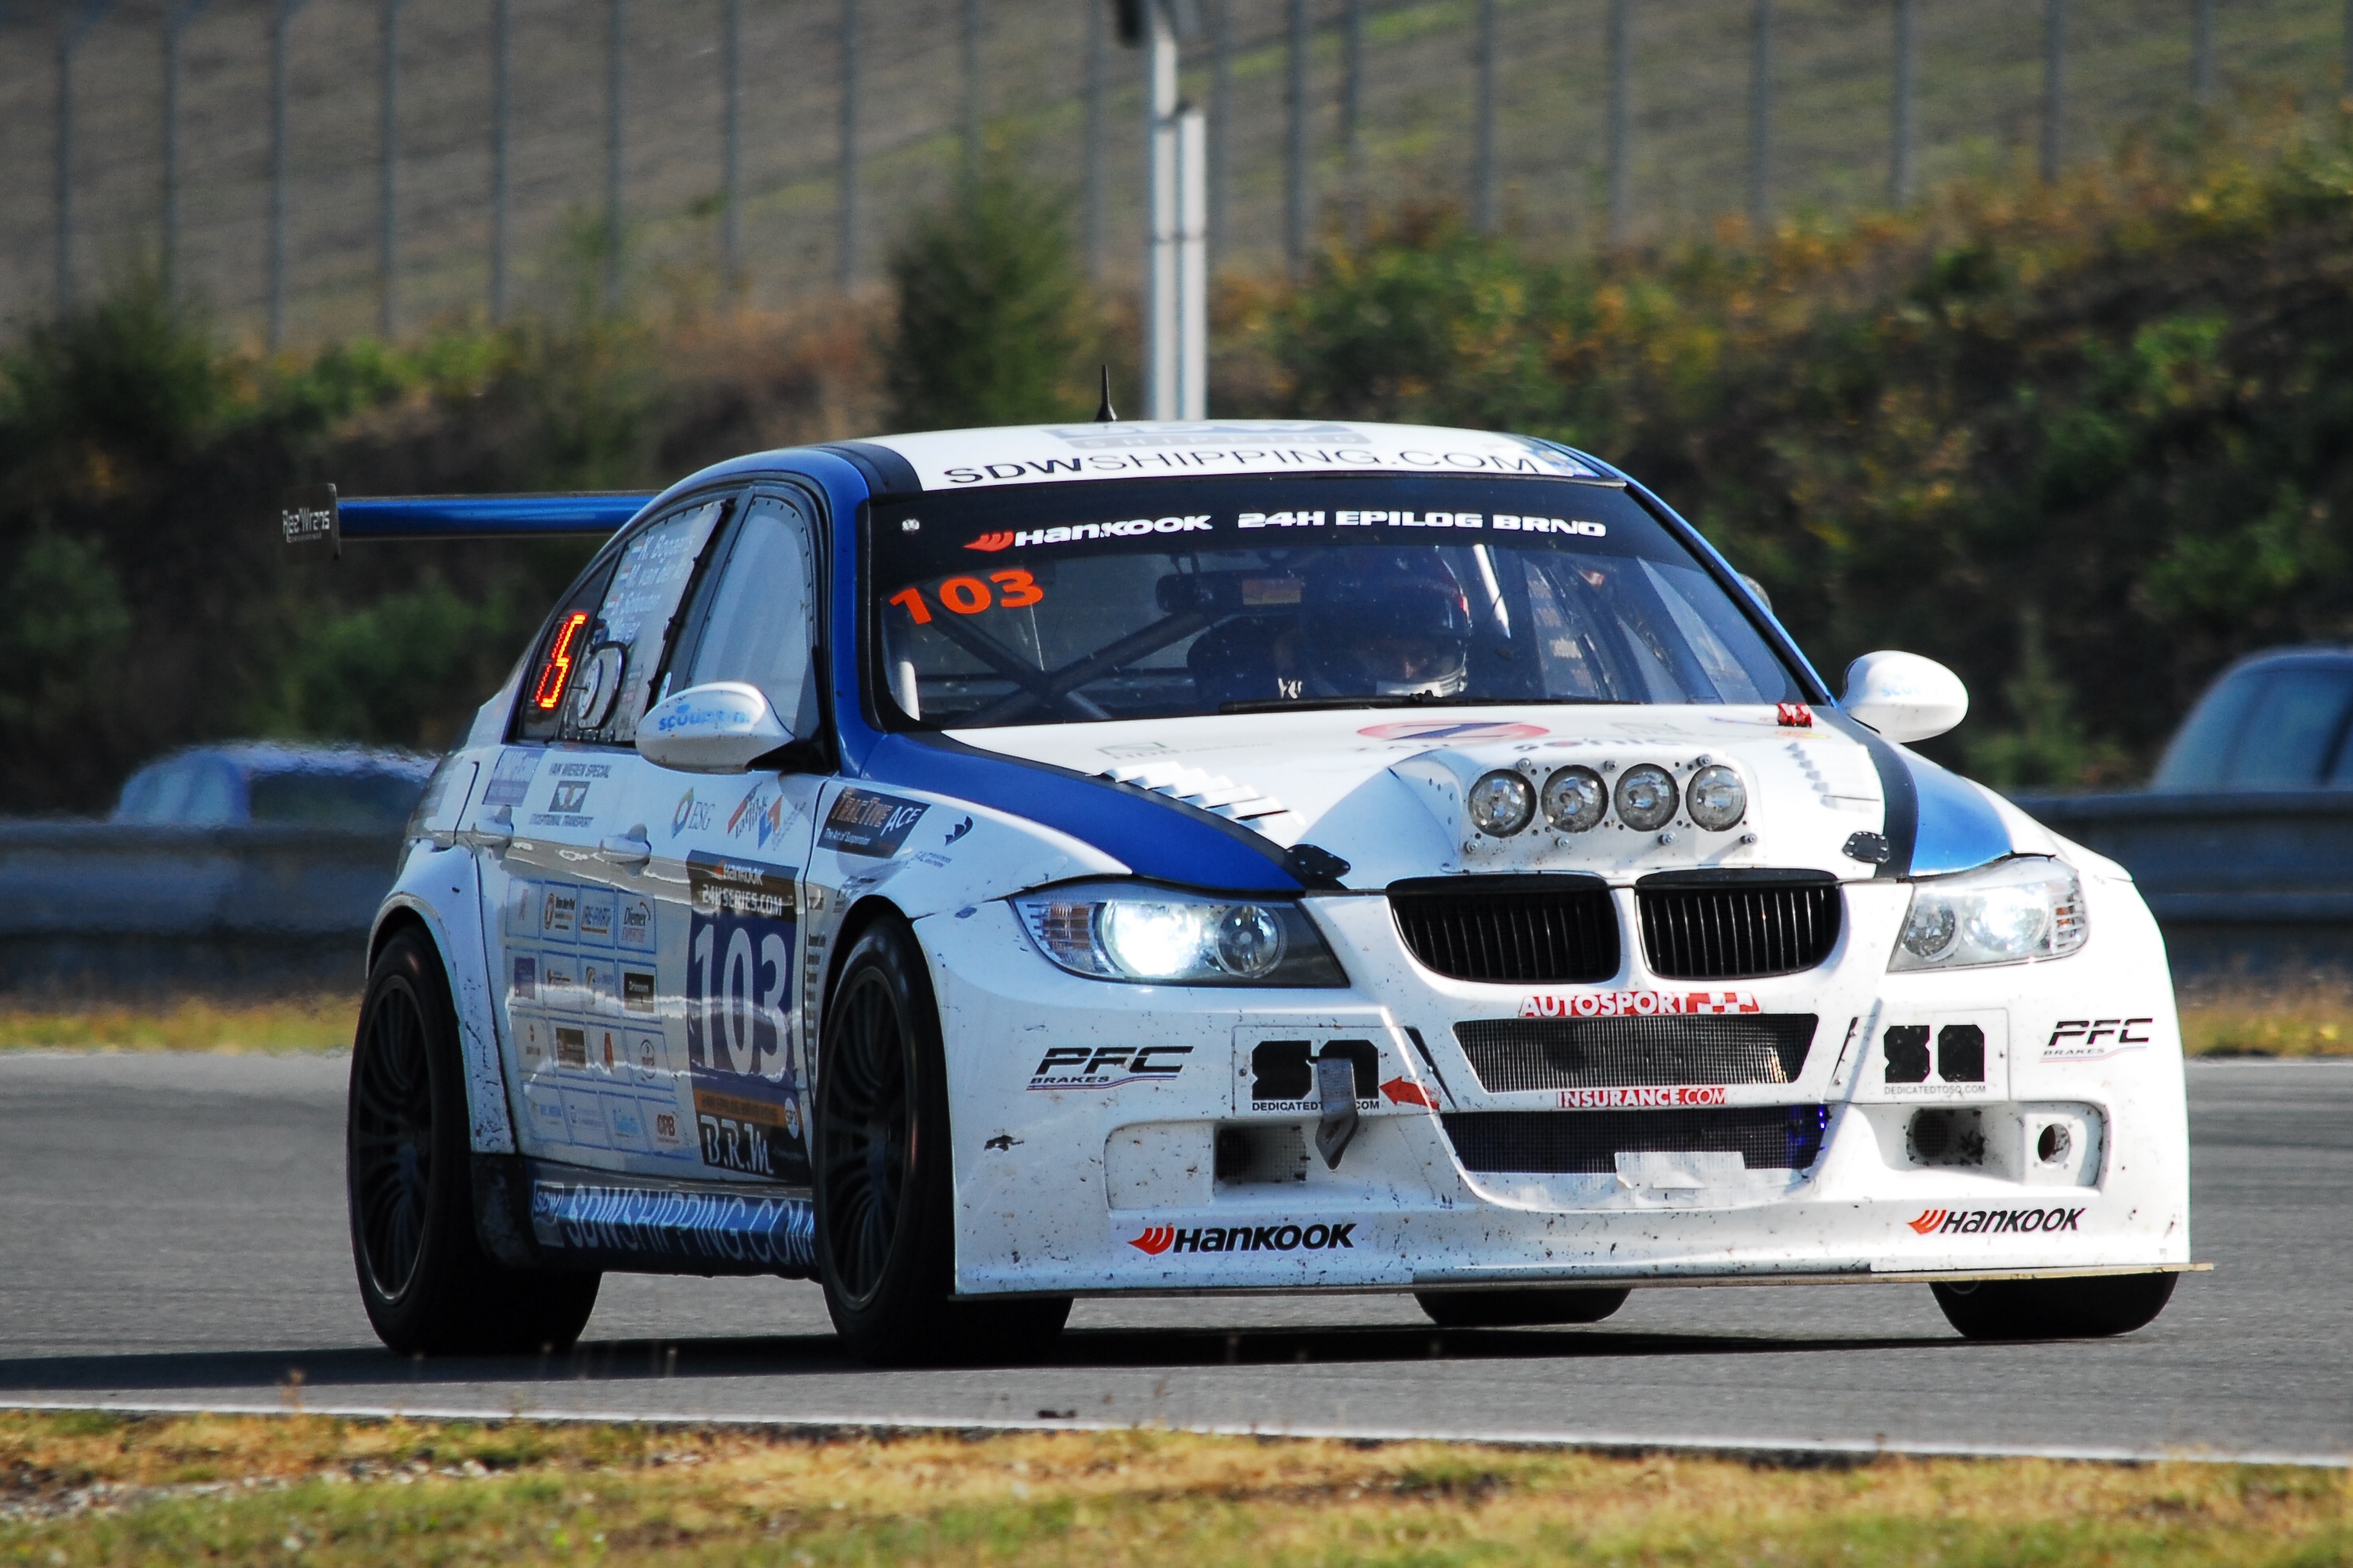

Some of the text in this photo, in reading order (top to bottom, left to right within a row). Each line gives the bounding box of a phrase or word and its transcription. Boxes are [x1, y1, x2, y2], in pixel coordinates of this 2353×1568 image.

[943, 448, 1541, 484] SDWSHIPPING.COM
[1238, 510, 1607, 538] 24H EPILOG BRNO
[889, 568, 1045, 625] 103
[880, 805, 923, 837] ACE
[694, 923, 788, 1083] 103
[1520, 991, 1690, 1018] AUTOSPORT
[2047, 1018, 2153, 1046] PFC
[1034, 1046, 1194, 1075] PFC
[2043, 1047, 2105, 1056] BRAKES
[1031, 1075, 1111, 1085] BRAKES
[1557, 1087, 1727, 1109] INSURANCE.COM
[566, 1182, 818, 1268] SDWSHIPPING.COM
